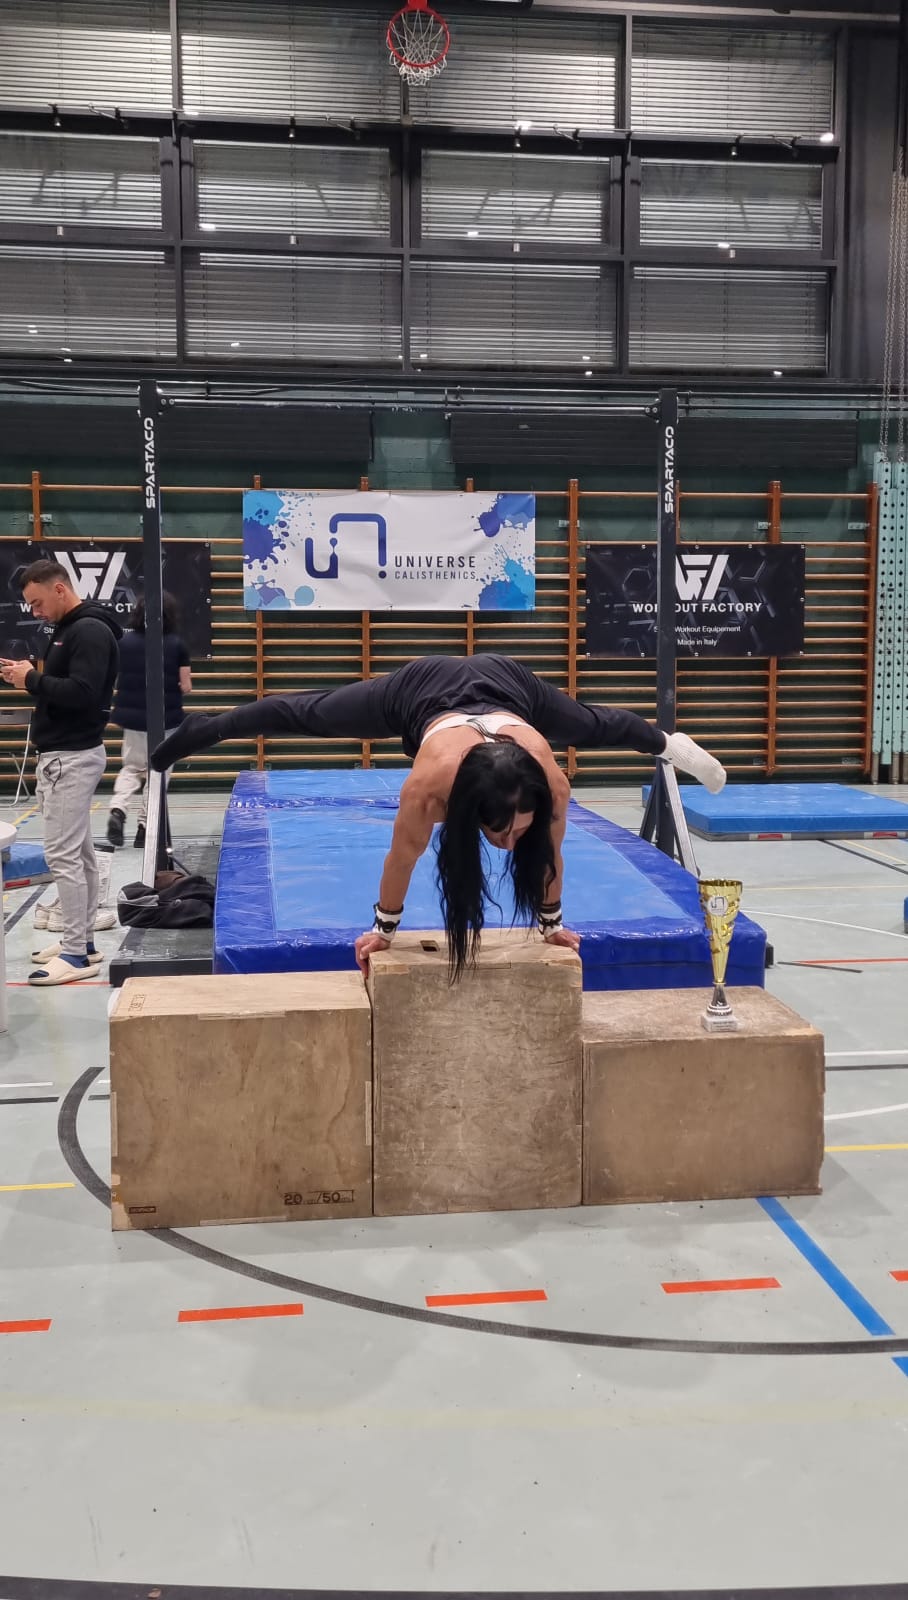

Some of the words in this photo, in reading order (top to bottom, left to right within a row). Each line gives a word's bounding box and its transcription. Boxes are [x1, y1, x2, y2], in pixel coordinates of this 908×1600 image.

[144, 417, 155, 508] SPARTACO
[665, 426, 674, 513] SPARTACO
[394, 555, 476, 568] UNIVERSE
[394, 570, 476, 580] CALISTHENICS
[702, 602, 762, 613] FACTORY
[677, 638, 695, 646] Made
[696, 638, 703, 646] in
[703, 638, 718, 647] Italy
